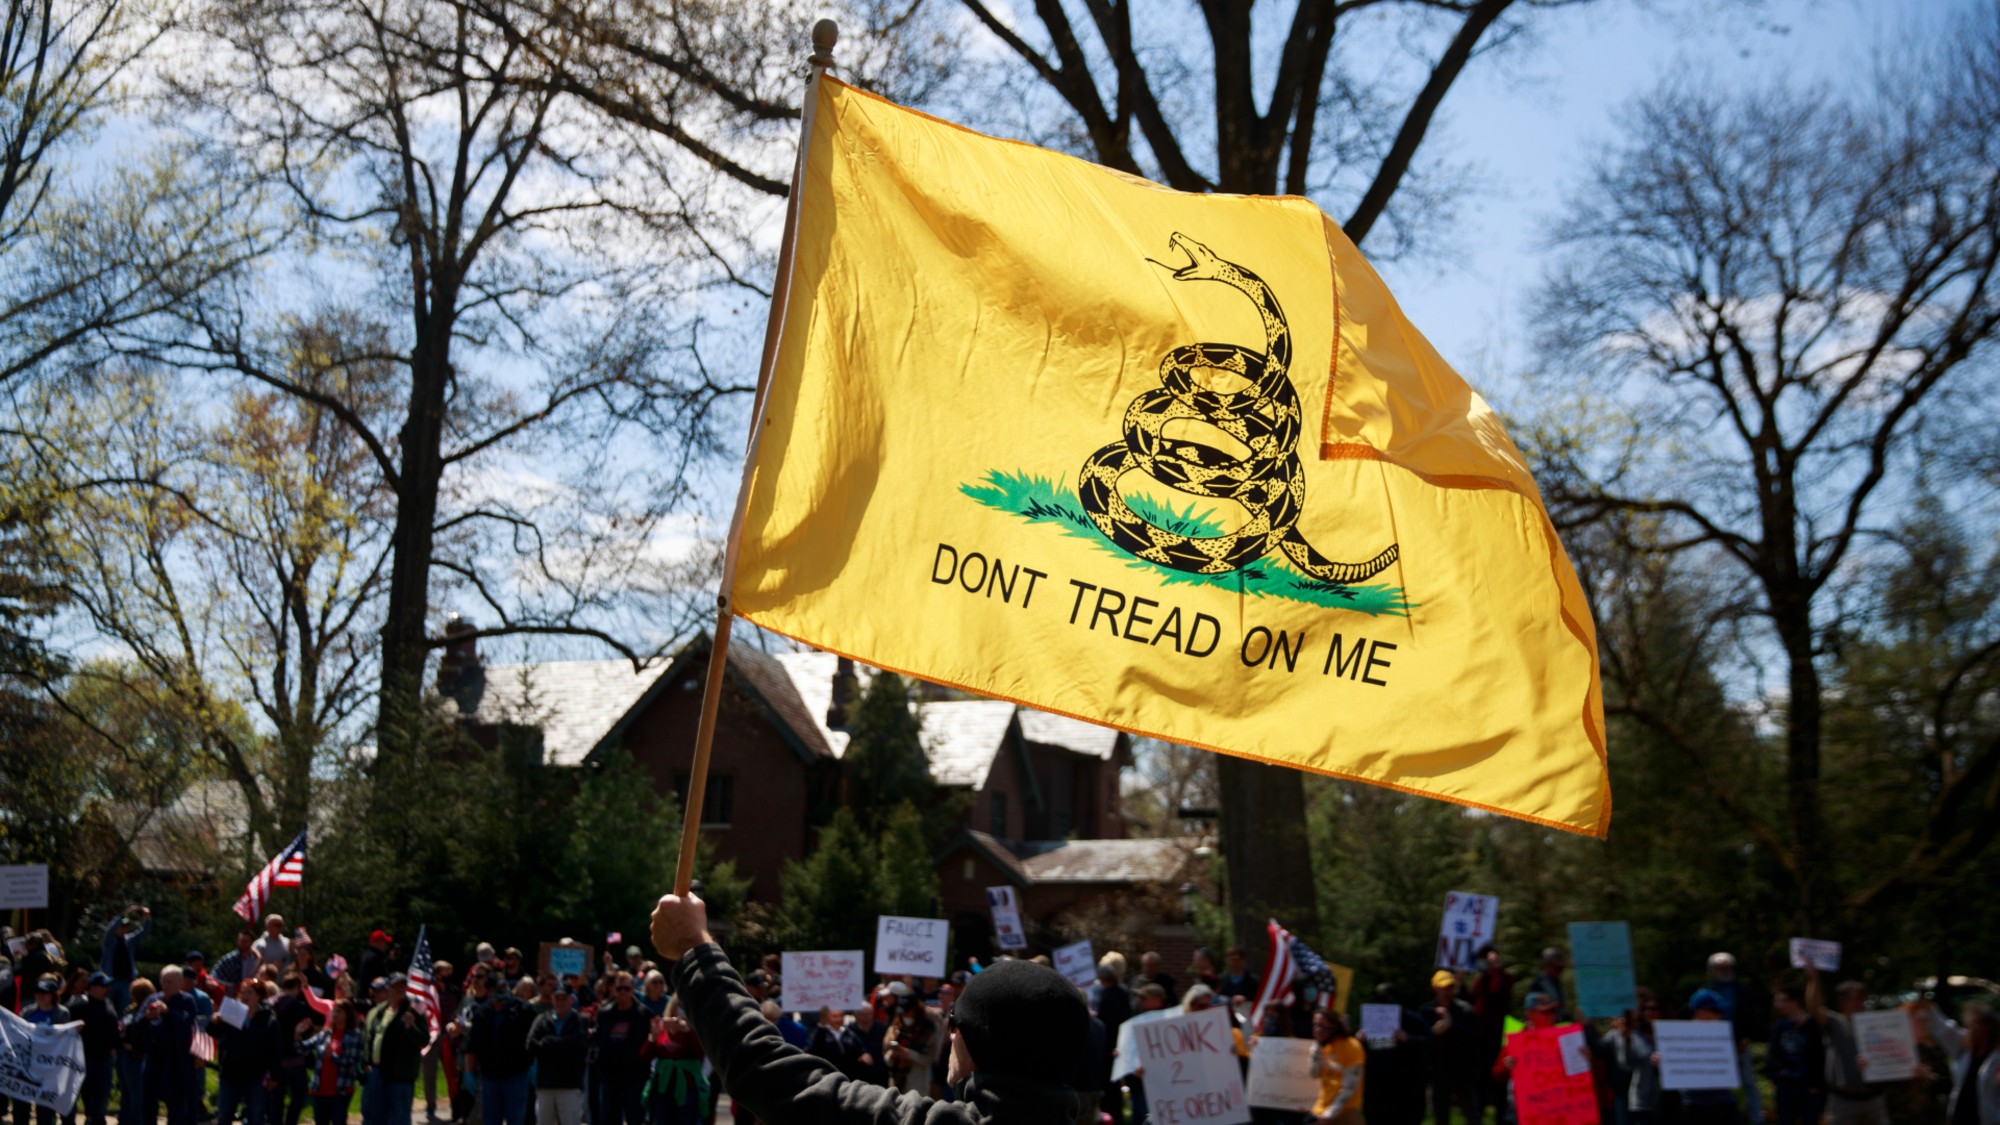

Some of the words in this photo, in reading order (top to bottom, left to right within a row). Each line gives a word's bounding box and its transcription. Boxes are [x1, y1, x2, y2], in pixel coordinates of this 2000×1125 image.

[931, 543, 1048, 609] DONT
[1069, 579, 1221, 658] TREAD
[1240, 625, 1305, 673] ON
[1323, 633, 1397, 687] ME
[885, 919, 936, 938] FAUCI
[887, 947, 934, 964] WRONG
[36, 1053, 54, 1066] OR
[1169, 1060, 1194, 1085] 2
[39, 1088, 58, 1104] ME
